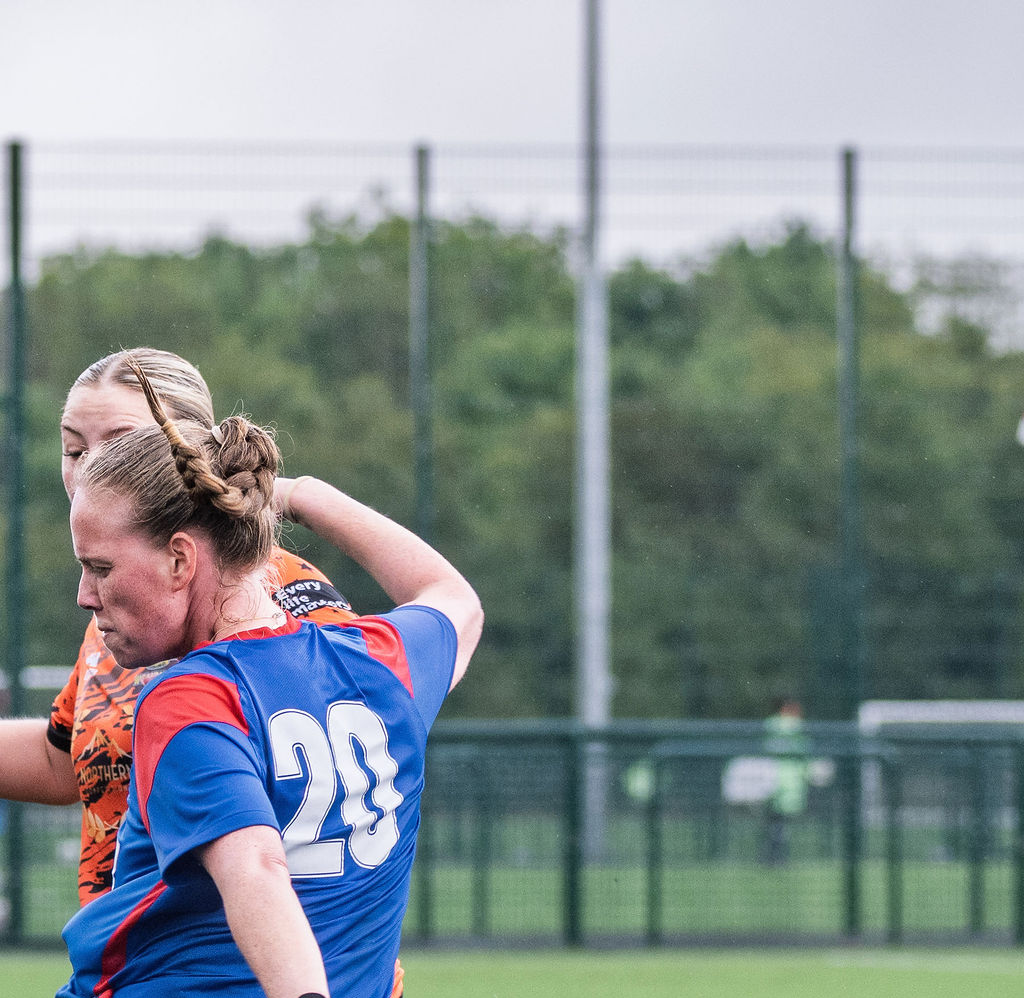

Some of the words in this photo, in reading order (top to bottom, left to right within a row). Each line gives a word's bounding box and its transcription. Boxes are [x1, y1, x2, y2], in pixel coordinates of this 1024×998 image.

[276, 582, 321, 600] Every
[282, 595, 310, 611] life
[292, 600, 352, 616] matters
[268, 700, 404, 878] 20
